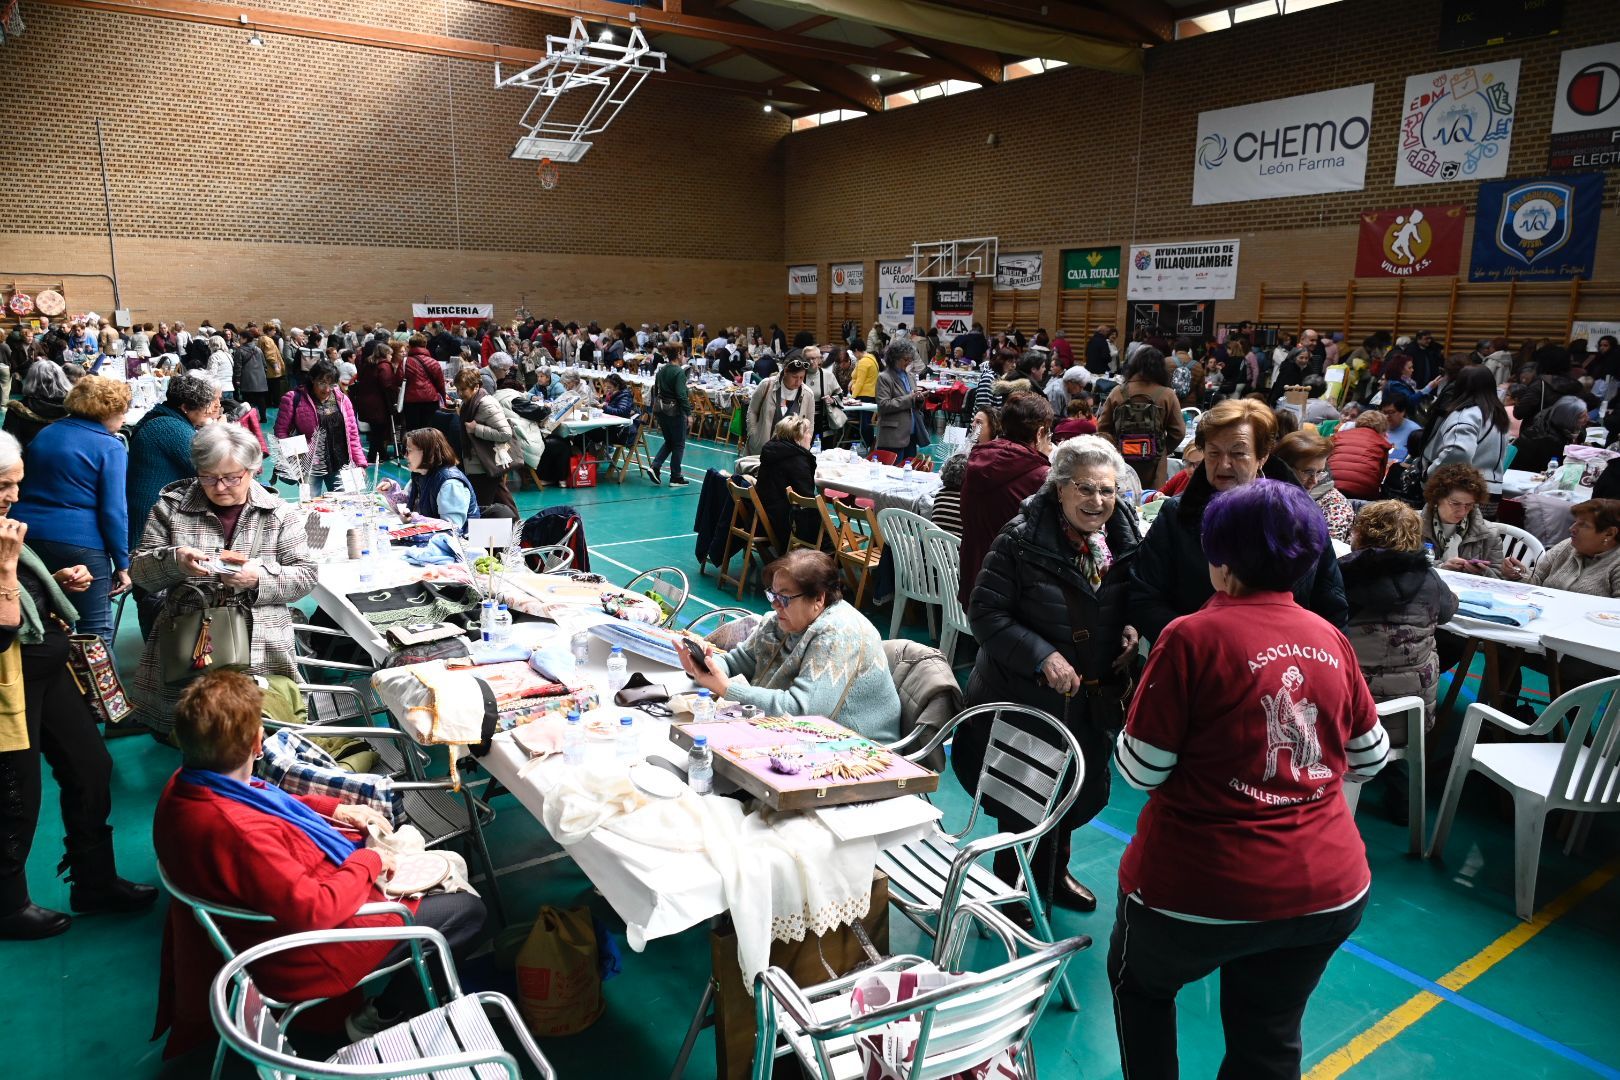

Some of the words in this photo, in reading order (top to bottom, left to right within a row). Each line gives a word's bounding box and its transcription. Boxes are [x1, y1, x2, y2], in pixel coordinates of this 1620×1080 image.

[1259, 161, 1294, 176] León
[1299, 156, 1345, 172] Farma
[1573, 151, 1620, 167] ELECT
[1155, 246, 1220, 256] AYUNTAMIENTO
[1222, 245, 1234, 253] DE
[1154, 255, 1233, 270] VILLAQUILAMBRE
[1381, 260, 1412, 275] VILLAKI
[881, 266, 902, 275] GALEA
[1068, 269, 1088, 279] CAJA
[1090, 268, 1119, 278] RURAL
[427, 306, 479, 315] MERCERIA
[1248, 643, 1339, 674] ASOCIACIÓN
